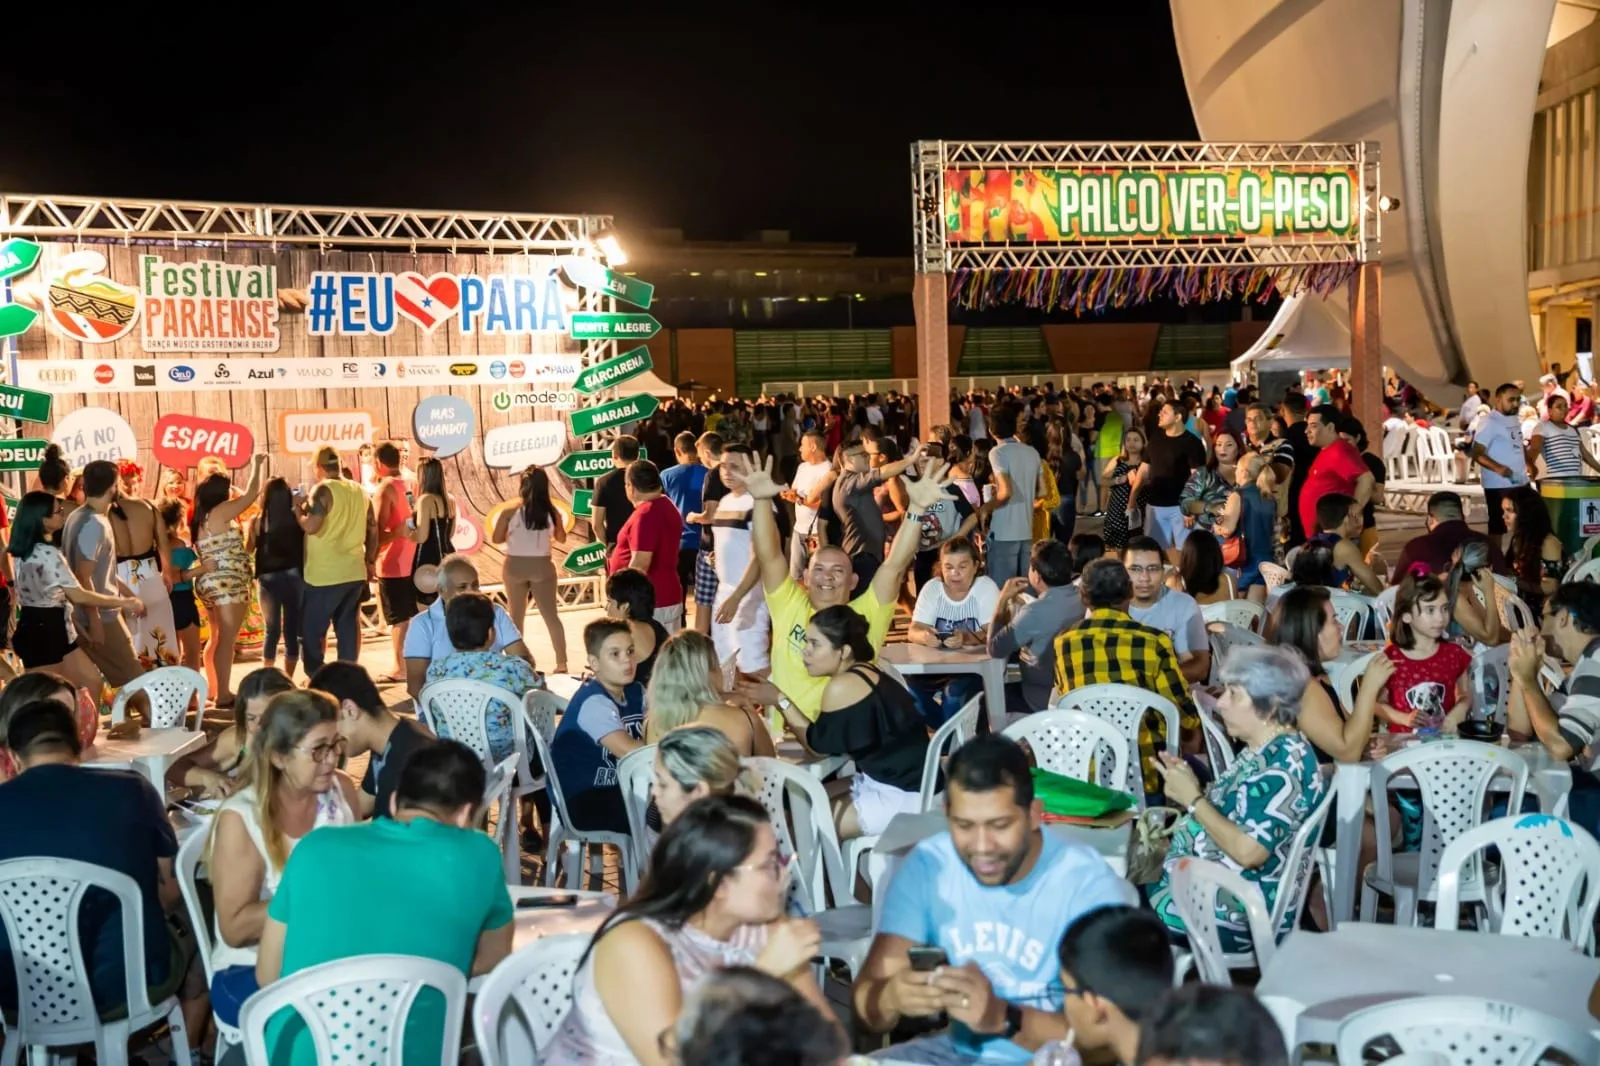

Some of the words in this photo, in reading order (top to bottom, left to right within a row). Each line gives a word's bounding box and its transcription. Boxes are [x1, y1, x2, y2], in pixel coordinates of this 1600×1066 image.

[1059, 177, 1160, 233] PALCO
[1168, 176, 1350, 232] VER-O-PESO
[144, 256, 273, 298] Festival
[310, 275, 395, 332] #EU
[461, 268, 566, 331] PARÁ
[145, 298, 275, 338] PARAENSE
[614, 322, 652, 333] ALEGRE
[248, 368, 275, 379] Azul
[583, 355, 645, 389] BARCARENA
[430, 407, 455, 420] MAS
[591, 401, 640, 426] MARABÁ
[62, 429, 86, 453] TÁ
[94, 426, 116, 446] NO
[161, 425, 239, 456] ESPIA!
[293, 423, 365, 442] UUULHA
[574, 457, 614, 472] ALGOD
[576, 548, 607, 566] SALIN
